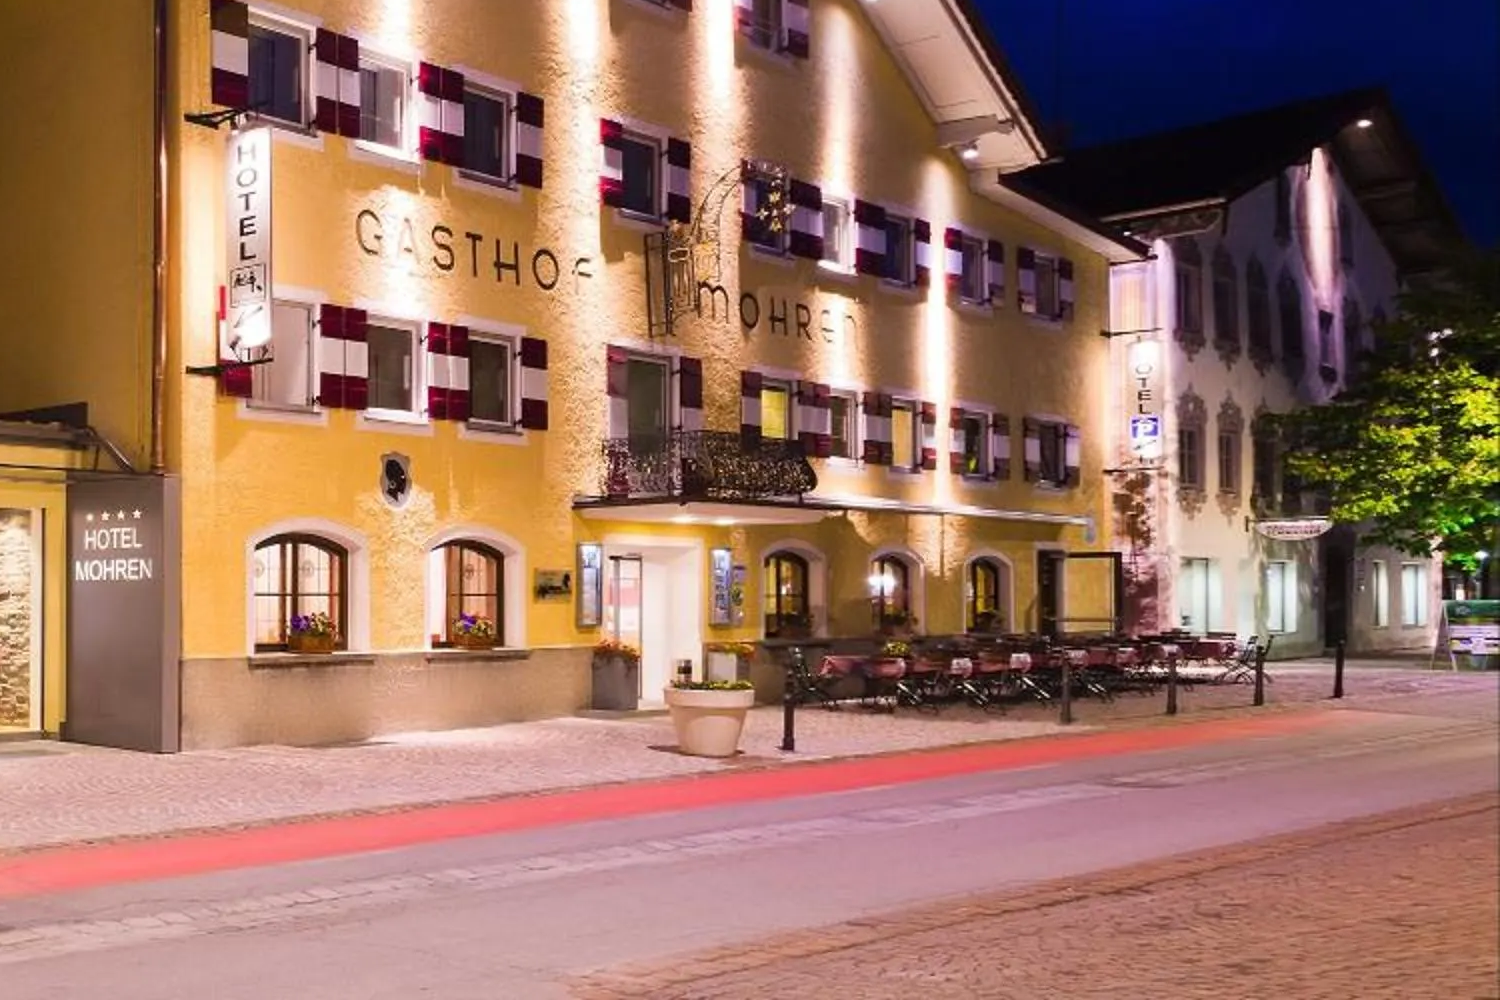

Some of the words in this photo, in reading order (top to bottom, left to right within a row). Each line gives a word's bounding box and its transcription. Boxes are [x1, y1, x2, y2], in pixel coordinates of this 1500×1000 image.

[236, 144, 257, 261] HOTEL
[355, 209, 592, 294] GASTHOF
[1136, 351, 1152, 414] OTEL
[75, 558, 152, 581] MOHREN
[84, 527, 142, 550] HOTEL
